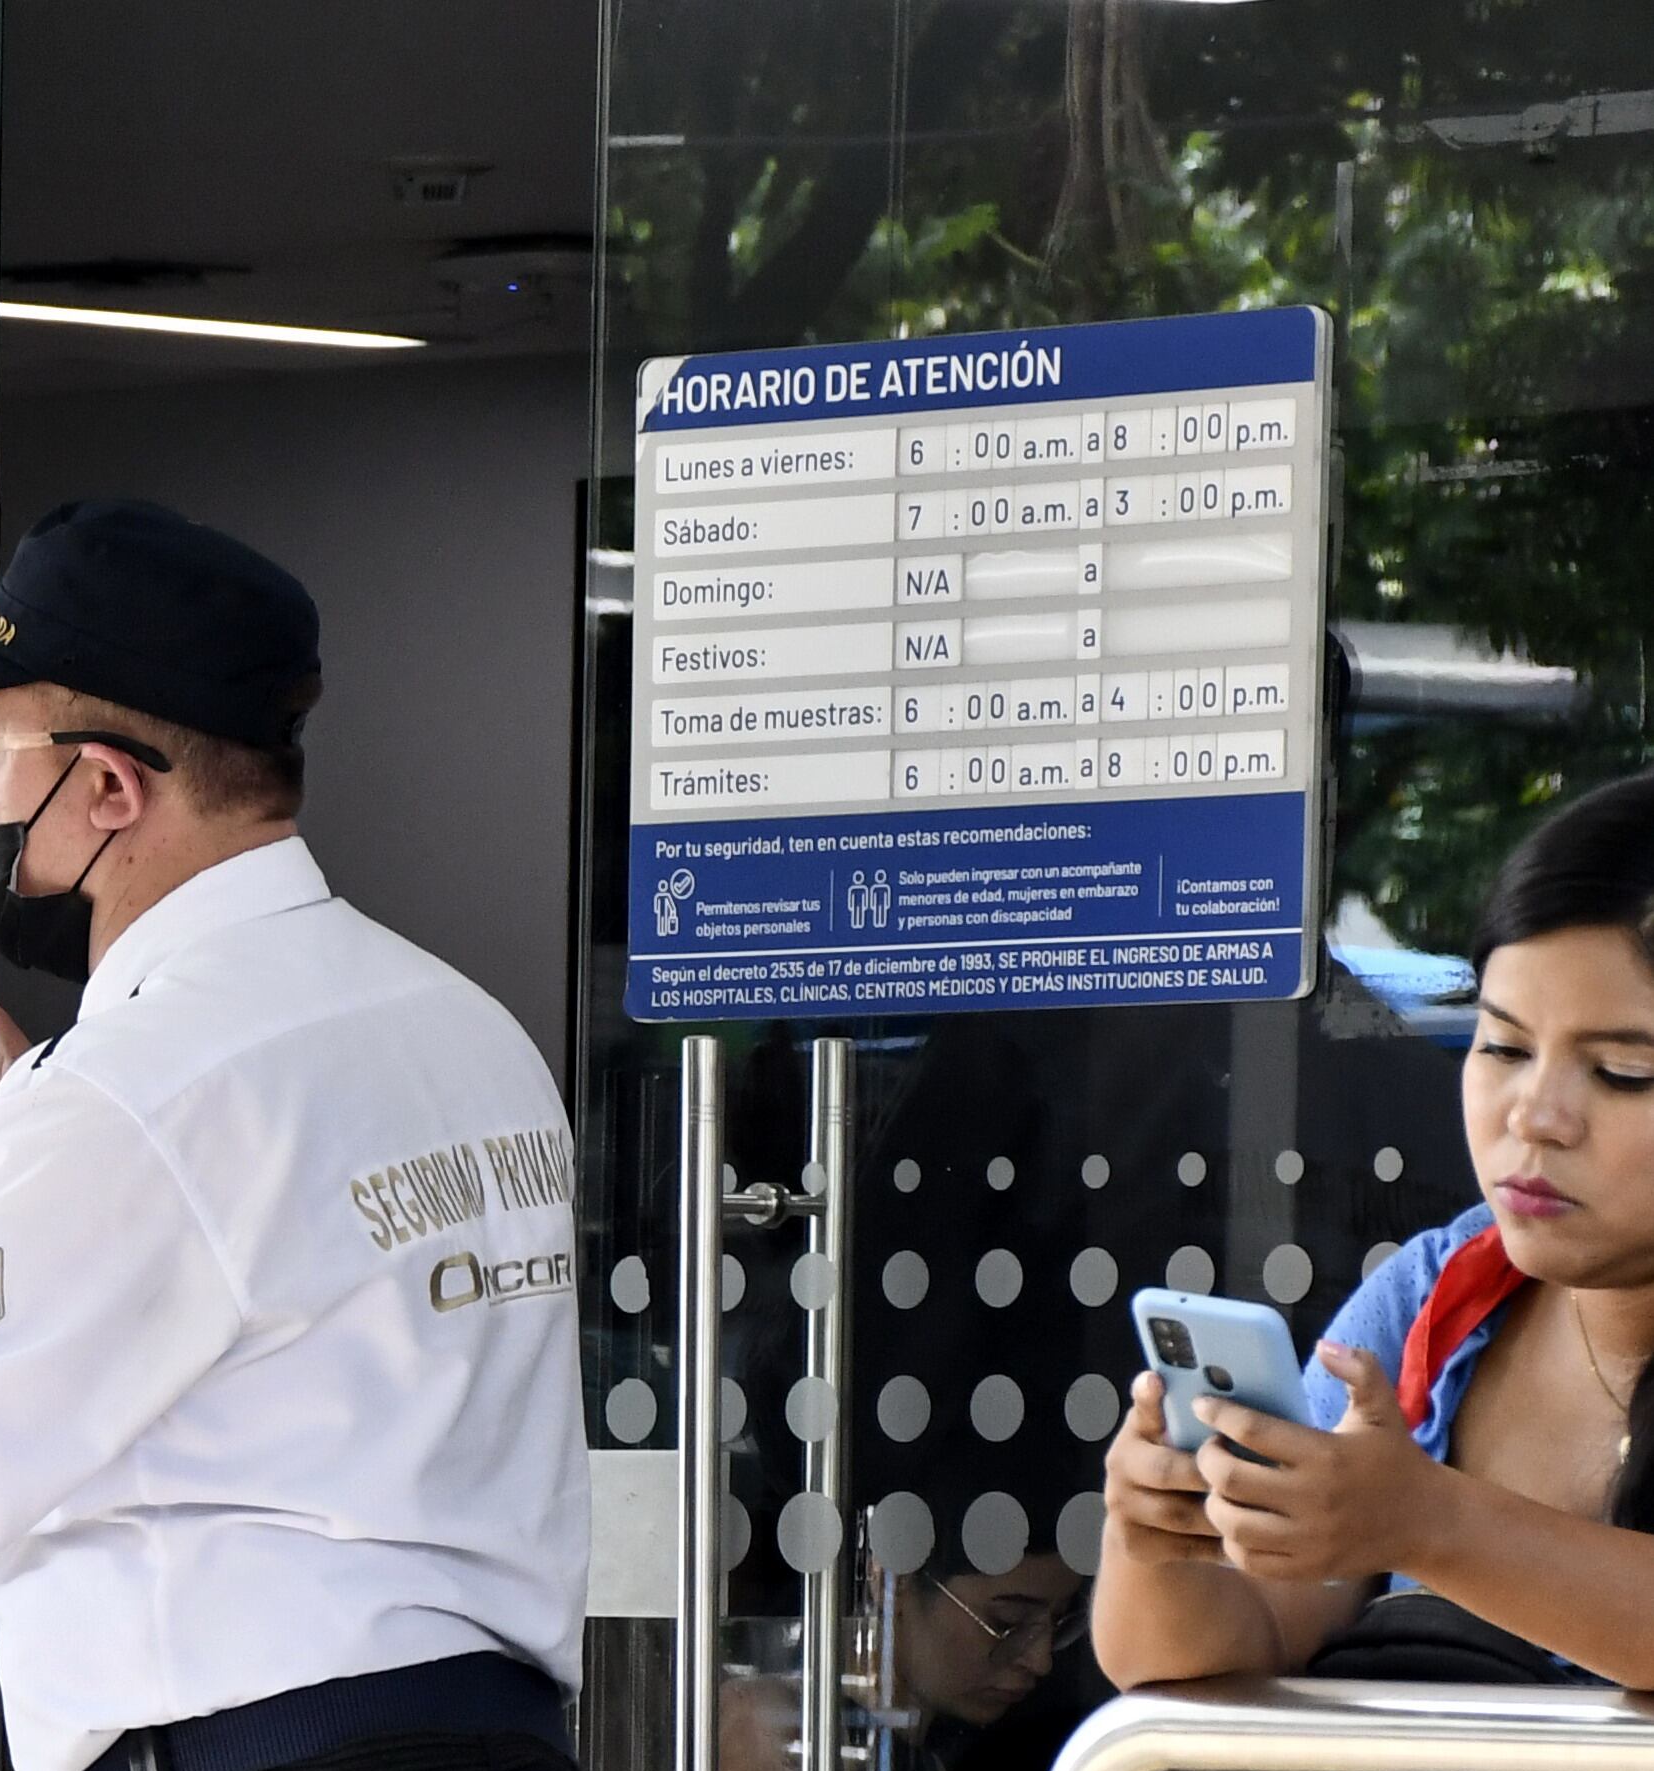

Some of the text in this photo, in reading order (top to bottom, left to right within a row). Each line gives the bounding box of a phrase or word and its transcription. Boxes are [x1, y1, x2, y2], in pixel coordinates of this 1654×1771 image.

[659, 341, 1061, 415] HORARIO DE ATENCIÓN
[666, 458, 735, 482] Lunes
[741, 458, 754, 477] a
[761, 449, 854, 476] viernes:
[1024, 438, 1074, 460] a.m.
[1087, 432, 1100, 452] a
[1236, 422, 1292, 452] p.m.
[664, 516, 758, 546] Sábado:
[1021, 503, 1072, 525] a.m.
[1086, 498, 1099, 518] a
[1231, 489, 1284, 519] p.m.
[664, 563, 1097, 608] Domingo: N/A a
[662, 628, 1096, 673] Festivos: N/A a
[661, 710, 723, 736] Toma
[730, 707, 758, 732] de
[765, 703, 882, 730] muestras:
[1017, 700, 1068, 722] a.m.
[1082, 693, 1095, 713] a
[1233, 686, 1285, 714] p.m.
[660, 768, 769, 797] Trámites:
[1019, 766, 1069, 786] a.m.
[1080, 758, 1093, 778] a
[1224, 753, 1276, 783] p.m.
[656, 823, 1092, 859] Por tu seguridad, ten en cuenta estas recomendaciones:
[1175, 897, 1280, 916] tu colaboración!
[1177, 878, 1274, 895] ¡Contamos con
[652, 941, 1274, 986] Según el decreto 2535 de 17 de diciembre de 1993, SE PROHIBE EL INGRESO DE ARMAS A
[350, 1143, 486, 1252] SEGURIDAD
